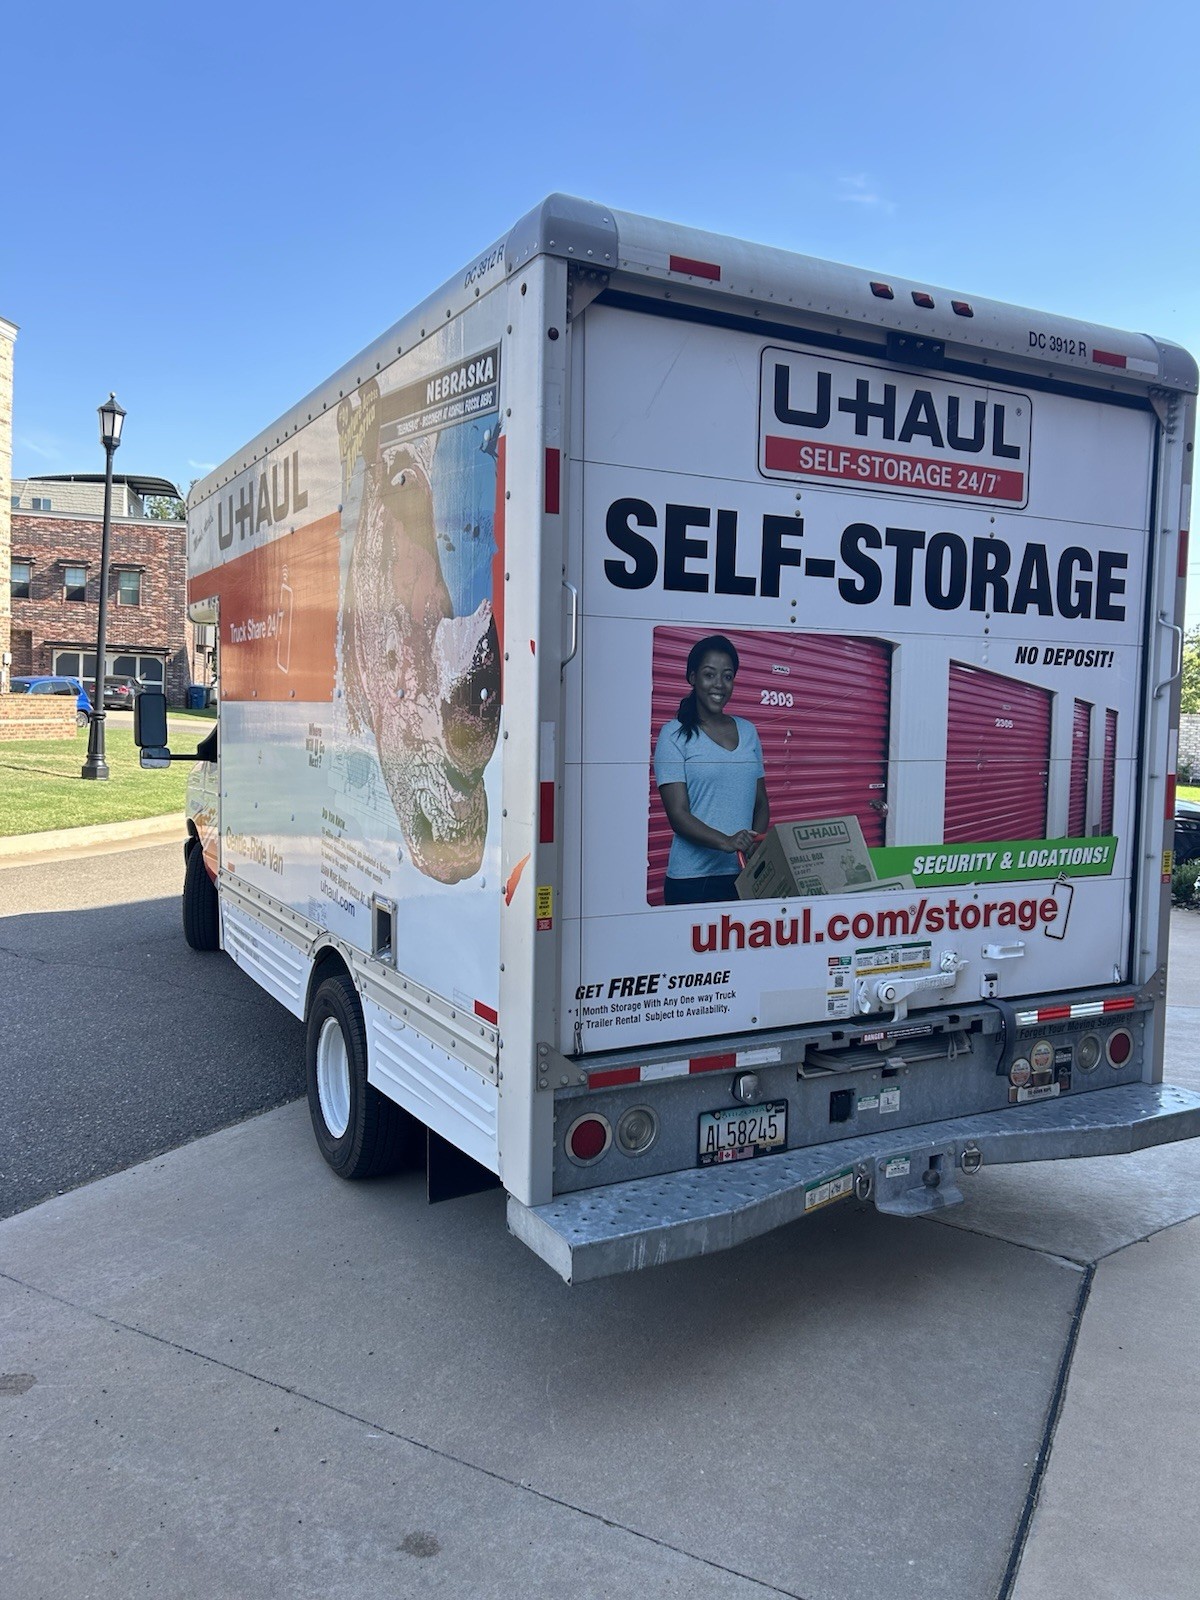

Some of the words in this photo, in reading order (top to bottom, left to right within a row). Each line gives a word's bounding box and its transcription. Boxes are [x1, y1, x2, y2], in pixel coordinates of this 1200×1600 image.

[496, 244, 505, 264] R
[1029, 331, 1046, 349] DC
[1049, 335, 1076, 355] 3912
[1078, 341, 1087, 357] R
[426, 356, 494, 405] NEBRASKA
[774, 363, 1021, 460] U-HAUL
[799, 446, 952, 489] SELF-STORAGE
[957, 469, 998, 494] 24/7
[218, 450, 309, 550] U-HAUL
[603, 496, 1129, 622] SELF-STORAGE
[230, 622, 247, 644] Truck
[247, 618, 266, 641] Share
[267, 607, 285, 640] 24/7
[1015, 646, 1039, 665] NO
[1043, 647, 1115, 668] DEPOSIT!
[760, 689, 794, 708] 2303
[797, 825, 846, 841] U-HAUL
[269, 844, 283, 875] Van
[790, 854, 811, 864] SMALL
[812, 852, 825, 862] BOX
[912, 852, 997, 875] SECURITY
[1000, 851, 1014, 870] &
[1017, 846, 1110, 869] LOCATIONS!
[320, 880, 356, 917] uhaul.com
[575, 984, 604, 1000] GET
[667, 970, 731, 990] STORAGE
[574, 1020, 584, 1031] Or
[586, 1018, 613, 1029] Trailer
[615, 1014, 641, 1026] Rental
[645, 1010, 675, 1022] Subject
[676, 1009, 685, 1018] to
[686, 1004, 730, 1017] Availability.
[582, 1005, 608, 1016] Month
[611, 1001, 641, 1013] Storage
[644, 999, 661, 1009] With
[663, 997, 678, 1007] Any
[680, 995, 695, 1005] One
[697, 993, 714, 1003] way
[715, 990, 737, 1001] Truck
[1020, 1026, 1047, 1039] Forget
[1049, 1023, 1066, 1034] Your
[1068, 1018, 1095, 1031] Moving
